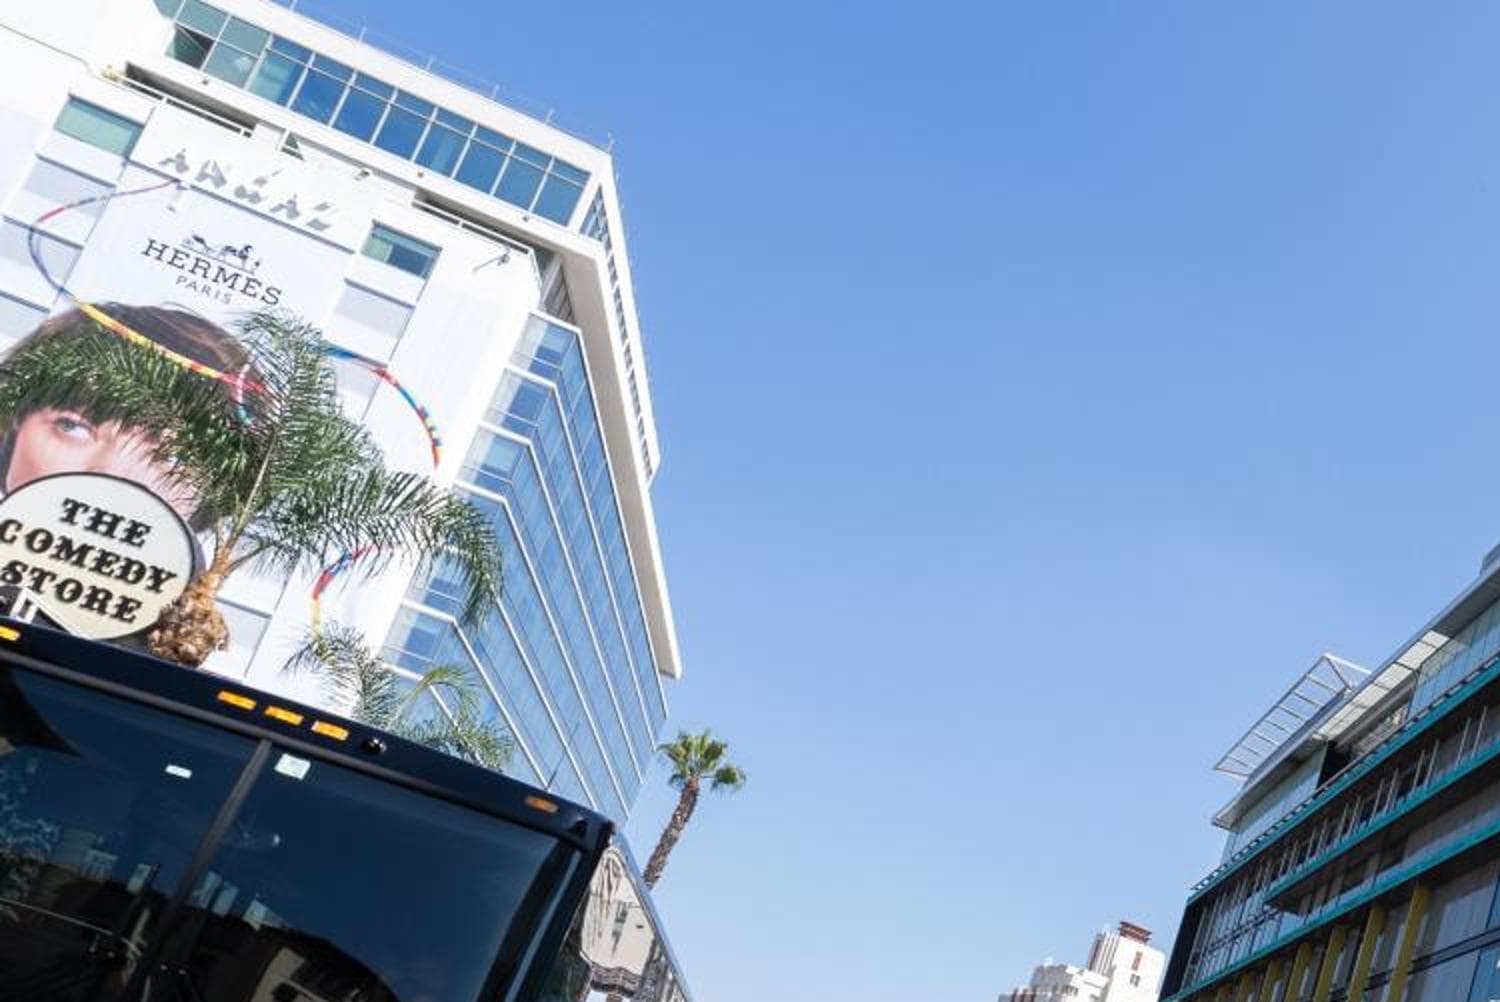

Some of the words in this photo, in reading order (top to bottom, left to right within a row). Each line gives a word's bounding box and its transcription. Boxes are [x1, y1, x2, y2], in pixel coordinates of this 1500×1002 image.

[176, 275, 231, 304] PARIS
[60, 497, 152, 548] THE
[0, 519, 177, 594] COMEDY
[0, 560, 143, 624] STORE
